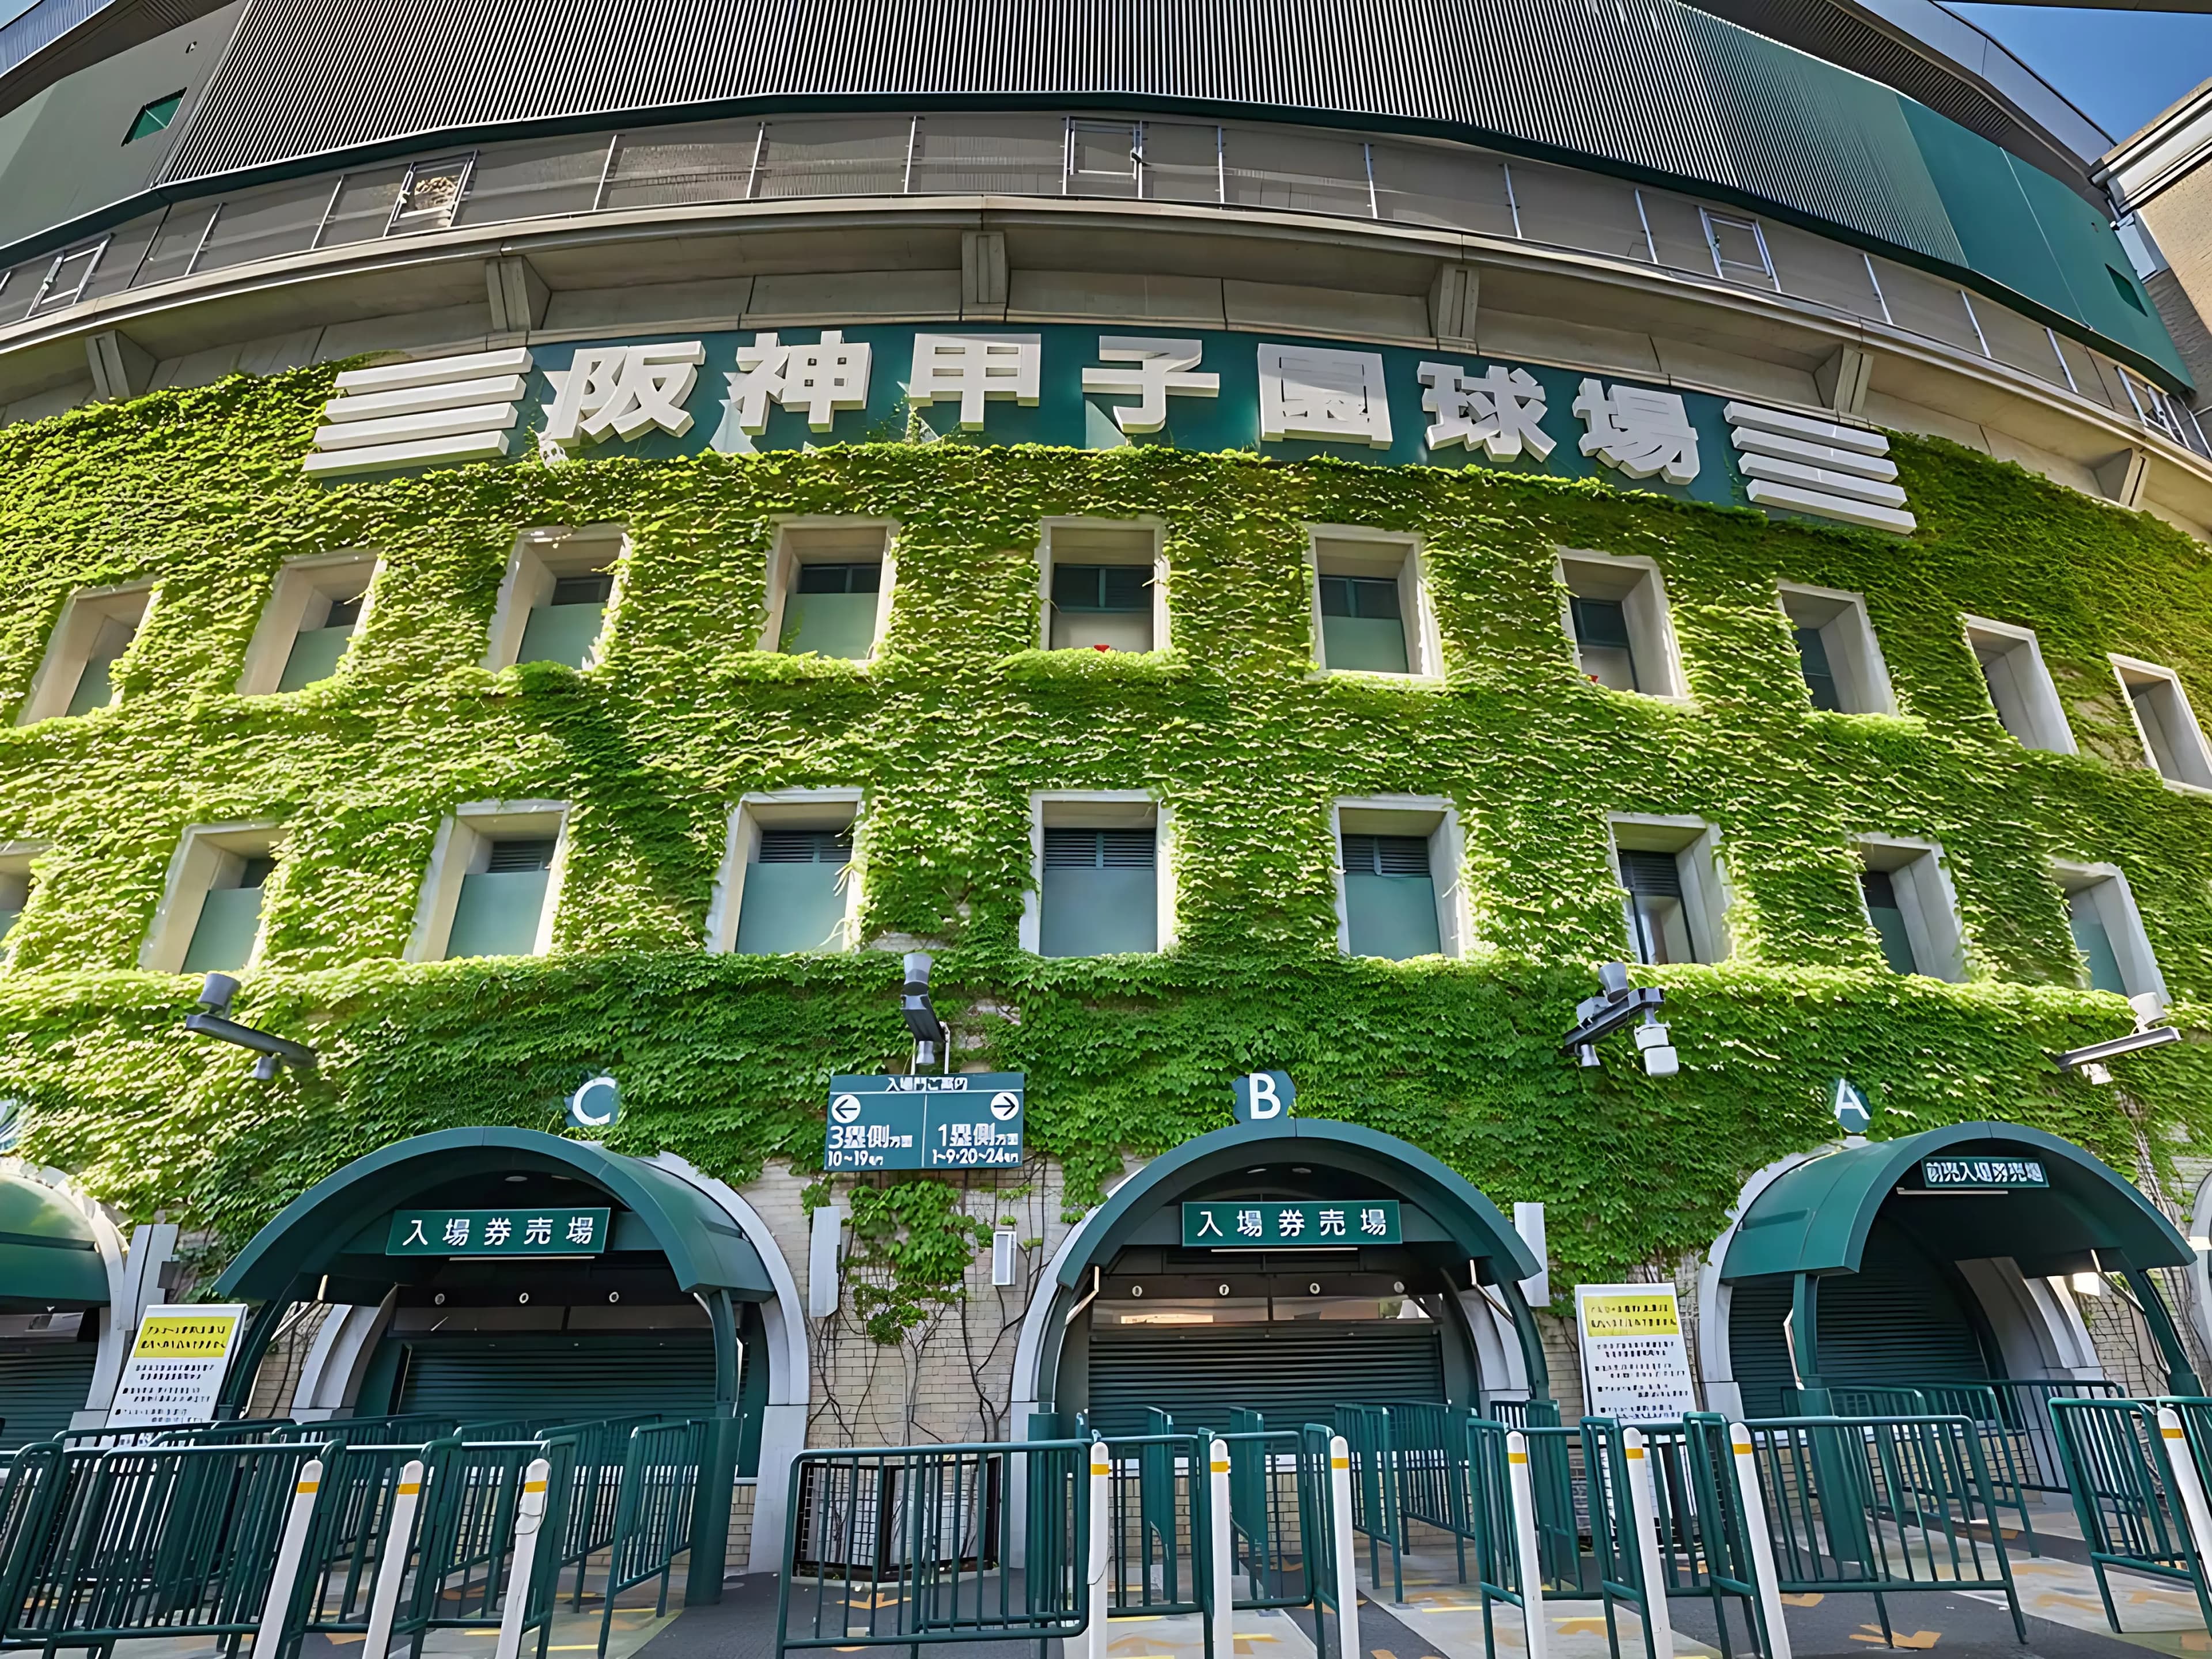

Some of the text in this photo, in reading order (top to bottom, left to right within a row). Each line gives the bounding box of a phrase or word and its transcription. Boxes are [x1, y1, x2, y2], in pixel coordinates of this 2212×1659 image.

[543, 328, 1700, 486] 阪神甲子園球場
[572, 1076, 616, 1126] C
[1249, 1073, 1281, 1120] B
[1833, 1078, 1871, 1120] A
[828, 1124, 913, 1149] 3塁側方
[1926, 1162, 2044, 1183] 前売入場券売
[402, 1217, 594, 1247] 入場券売場
[1196, 1209, 1387, 1237] 入場券売場
